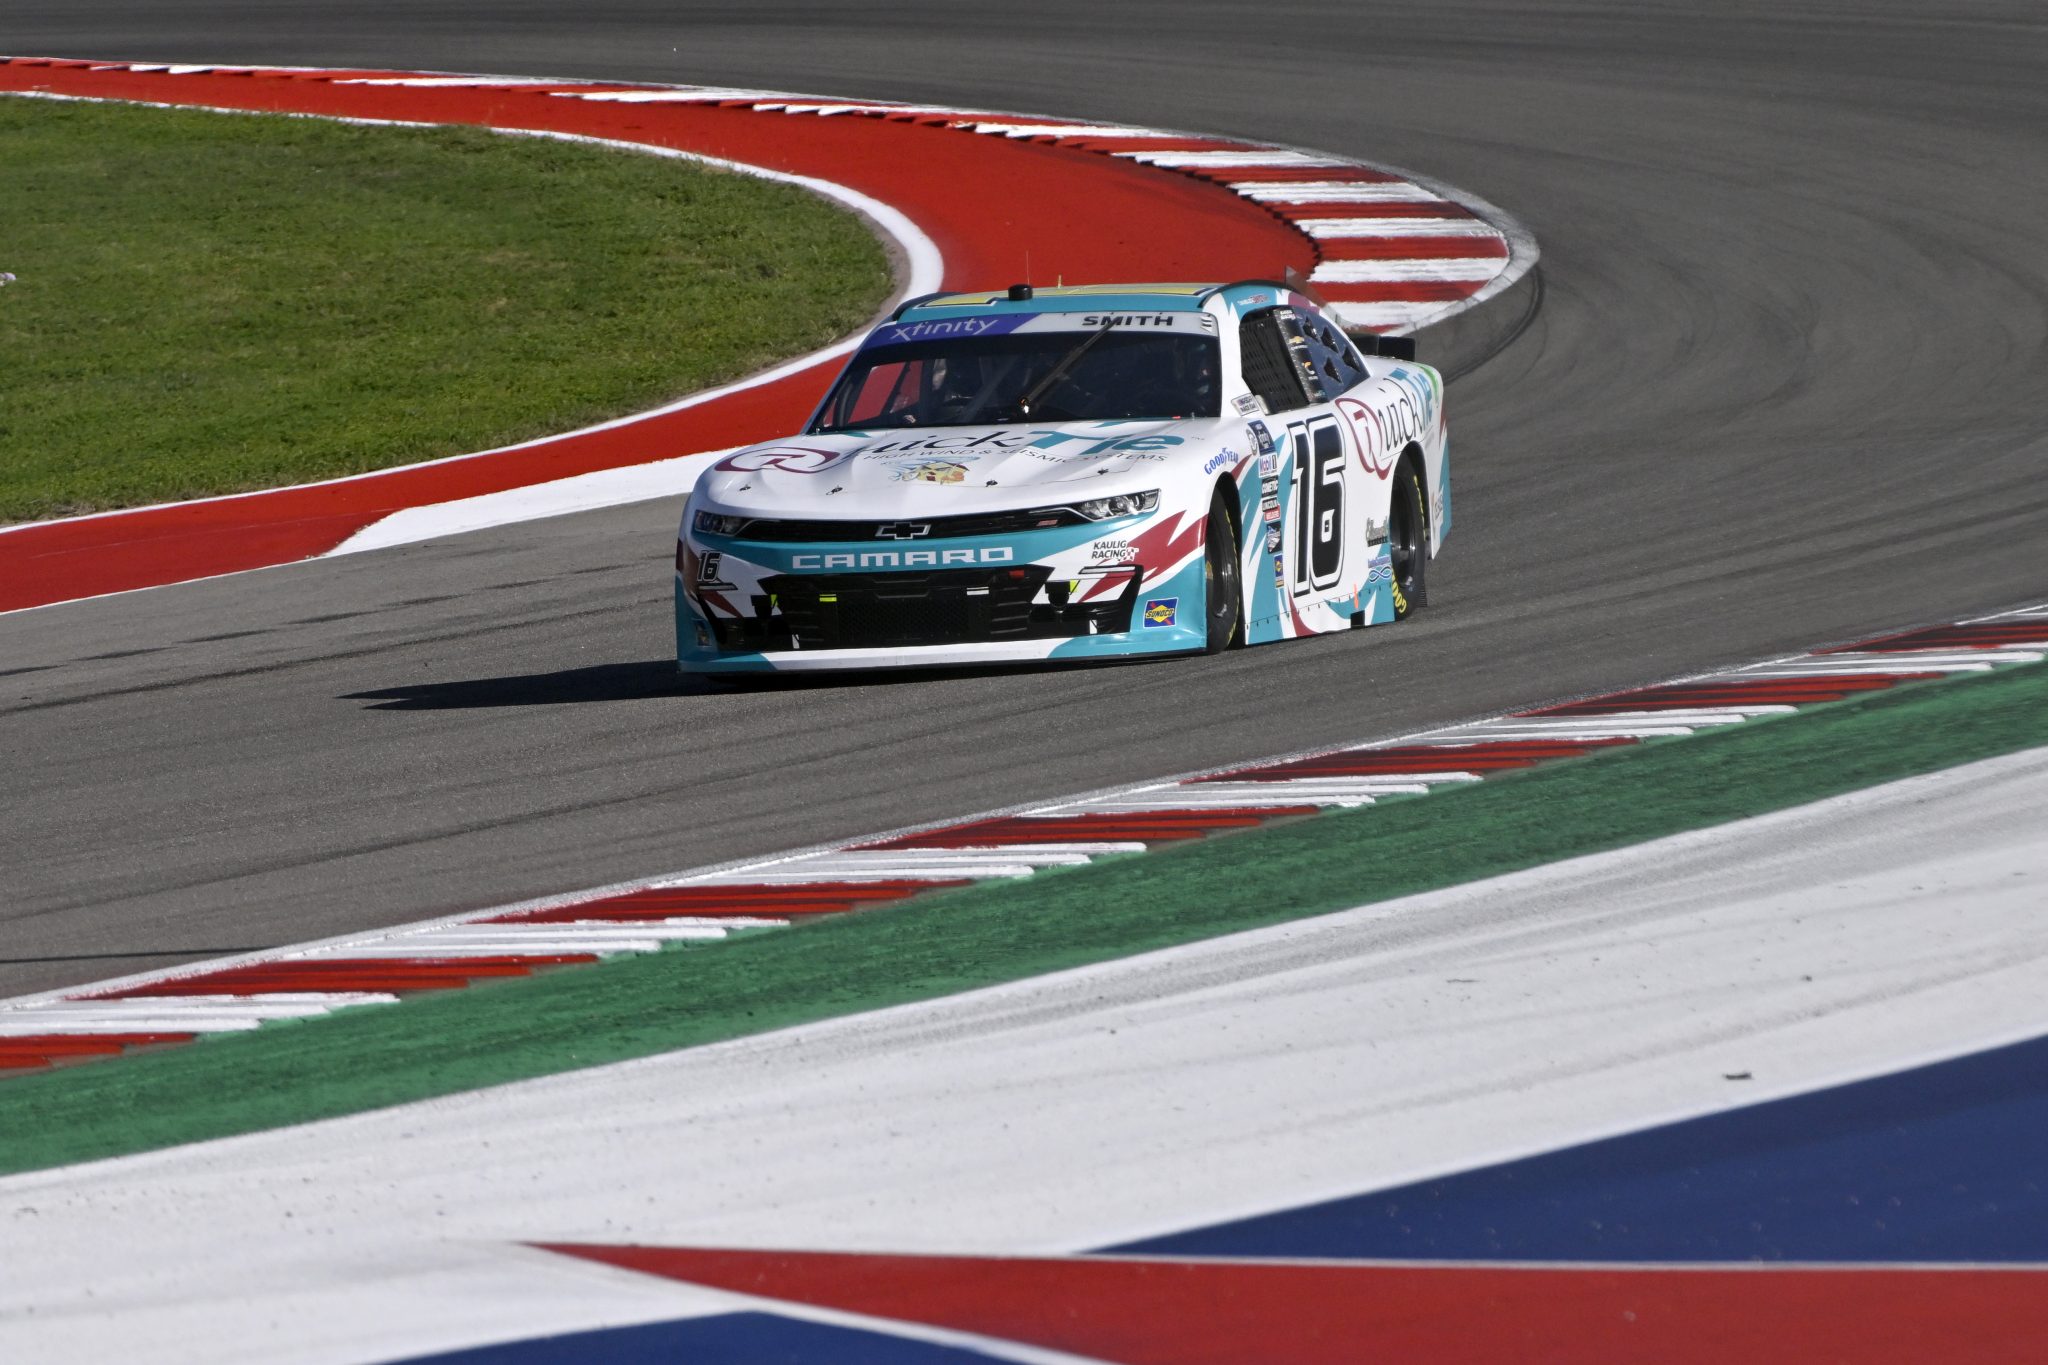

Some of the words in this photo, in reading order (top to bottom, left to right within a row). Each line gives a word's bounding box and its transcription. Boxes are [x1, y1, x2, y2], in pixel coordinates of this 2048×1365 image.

[1081, 315, 1173, 326] SMITH
[890, 317, 998, 341] xfinity
[1286, 412, 1347, 598] 16
[1093, 540, 1127, 550] KAULIG
[792, 547, 1013, 569] CAMARO
[1091, 550, 1126, 559] RACING
[697, 550, 722, 582] 16
[1145, 608, 1174, 618] SUNOCO
